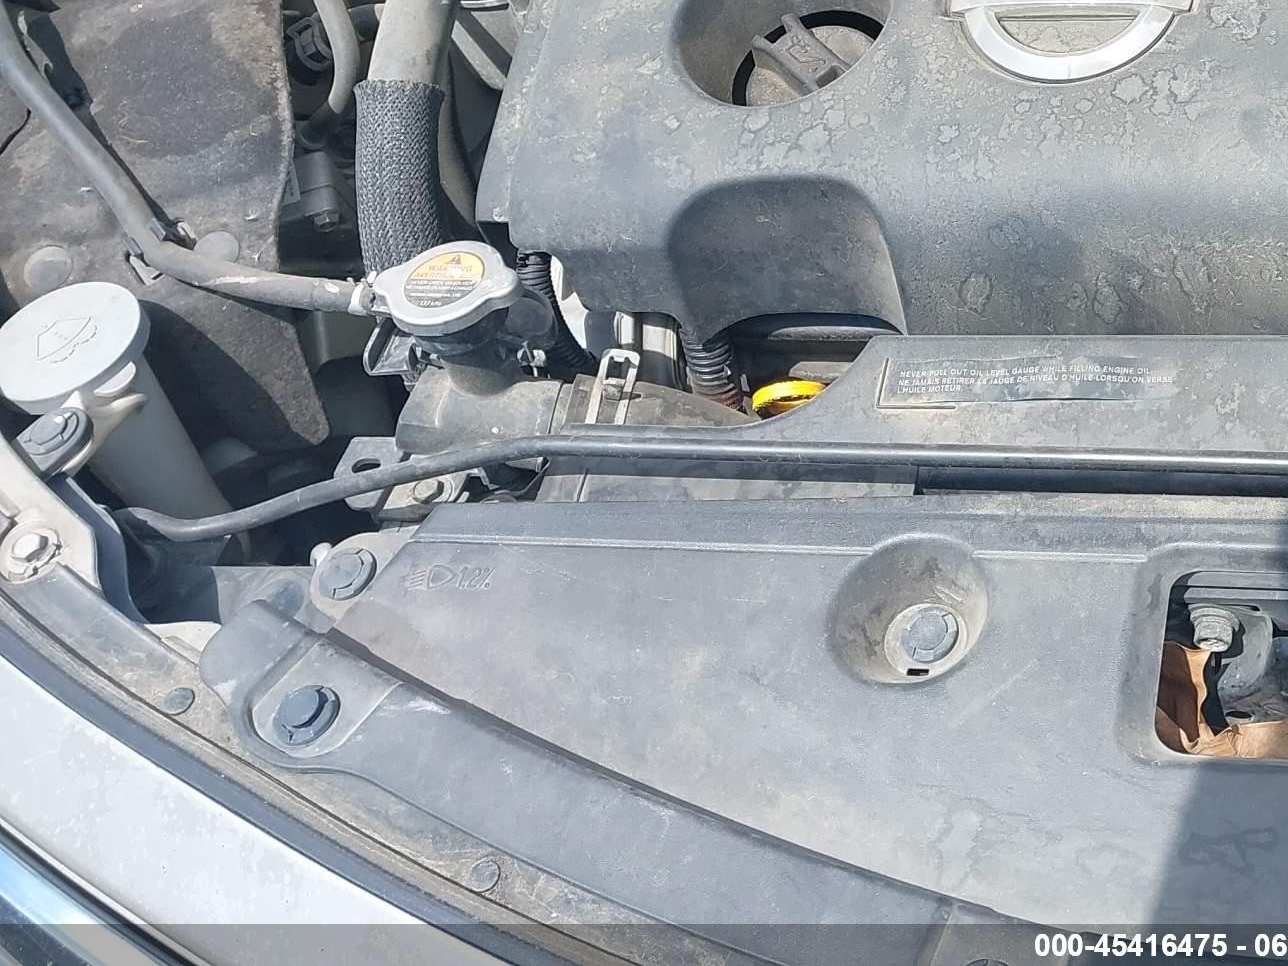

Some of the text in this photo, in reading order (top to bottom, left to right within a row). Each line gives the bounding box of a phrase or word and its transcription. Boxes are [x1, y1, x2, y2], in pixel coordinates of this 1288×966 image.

[900, 370, 926, 378] NEVER
[950, 368, 968, 376] OUT
[970, 369, 983, 377] OIL
[986, 368, 1009, 376] LEVEL
[1011, 366, 1039, 375] GAUGE
[1042, 365, 1067, 373] WHILE
[1069, 365, 1100, 373] FILLING
[1102, 365, 1134, 374] ENGINE
[911, 378, 939, 387] JAMAIS
[941, 377, 976, 385] RETIRER
[1029, 374, 1059, 383] NIVEAU
[1146, 375, 1173, 383] VERSE
